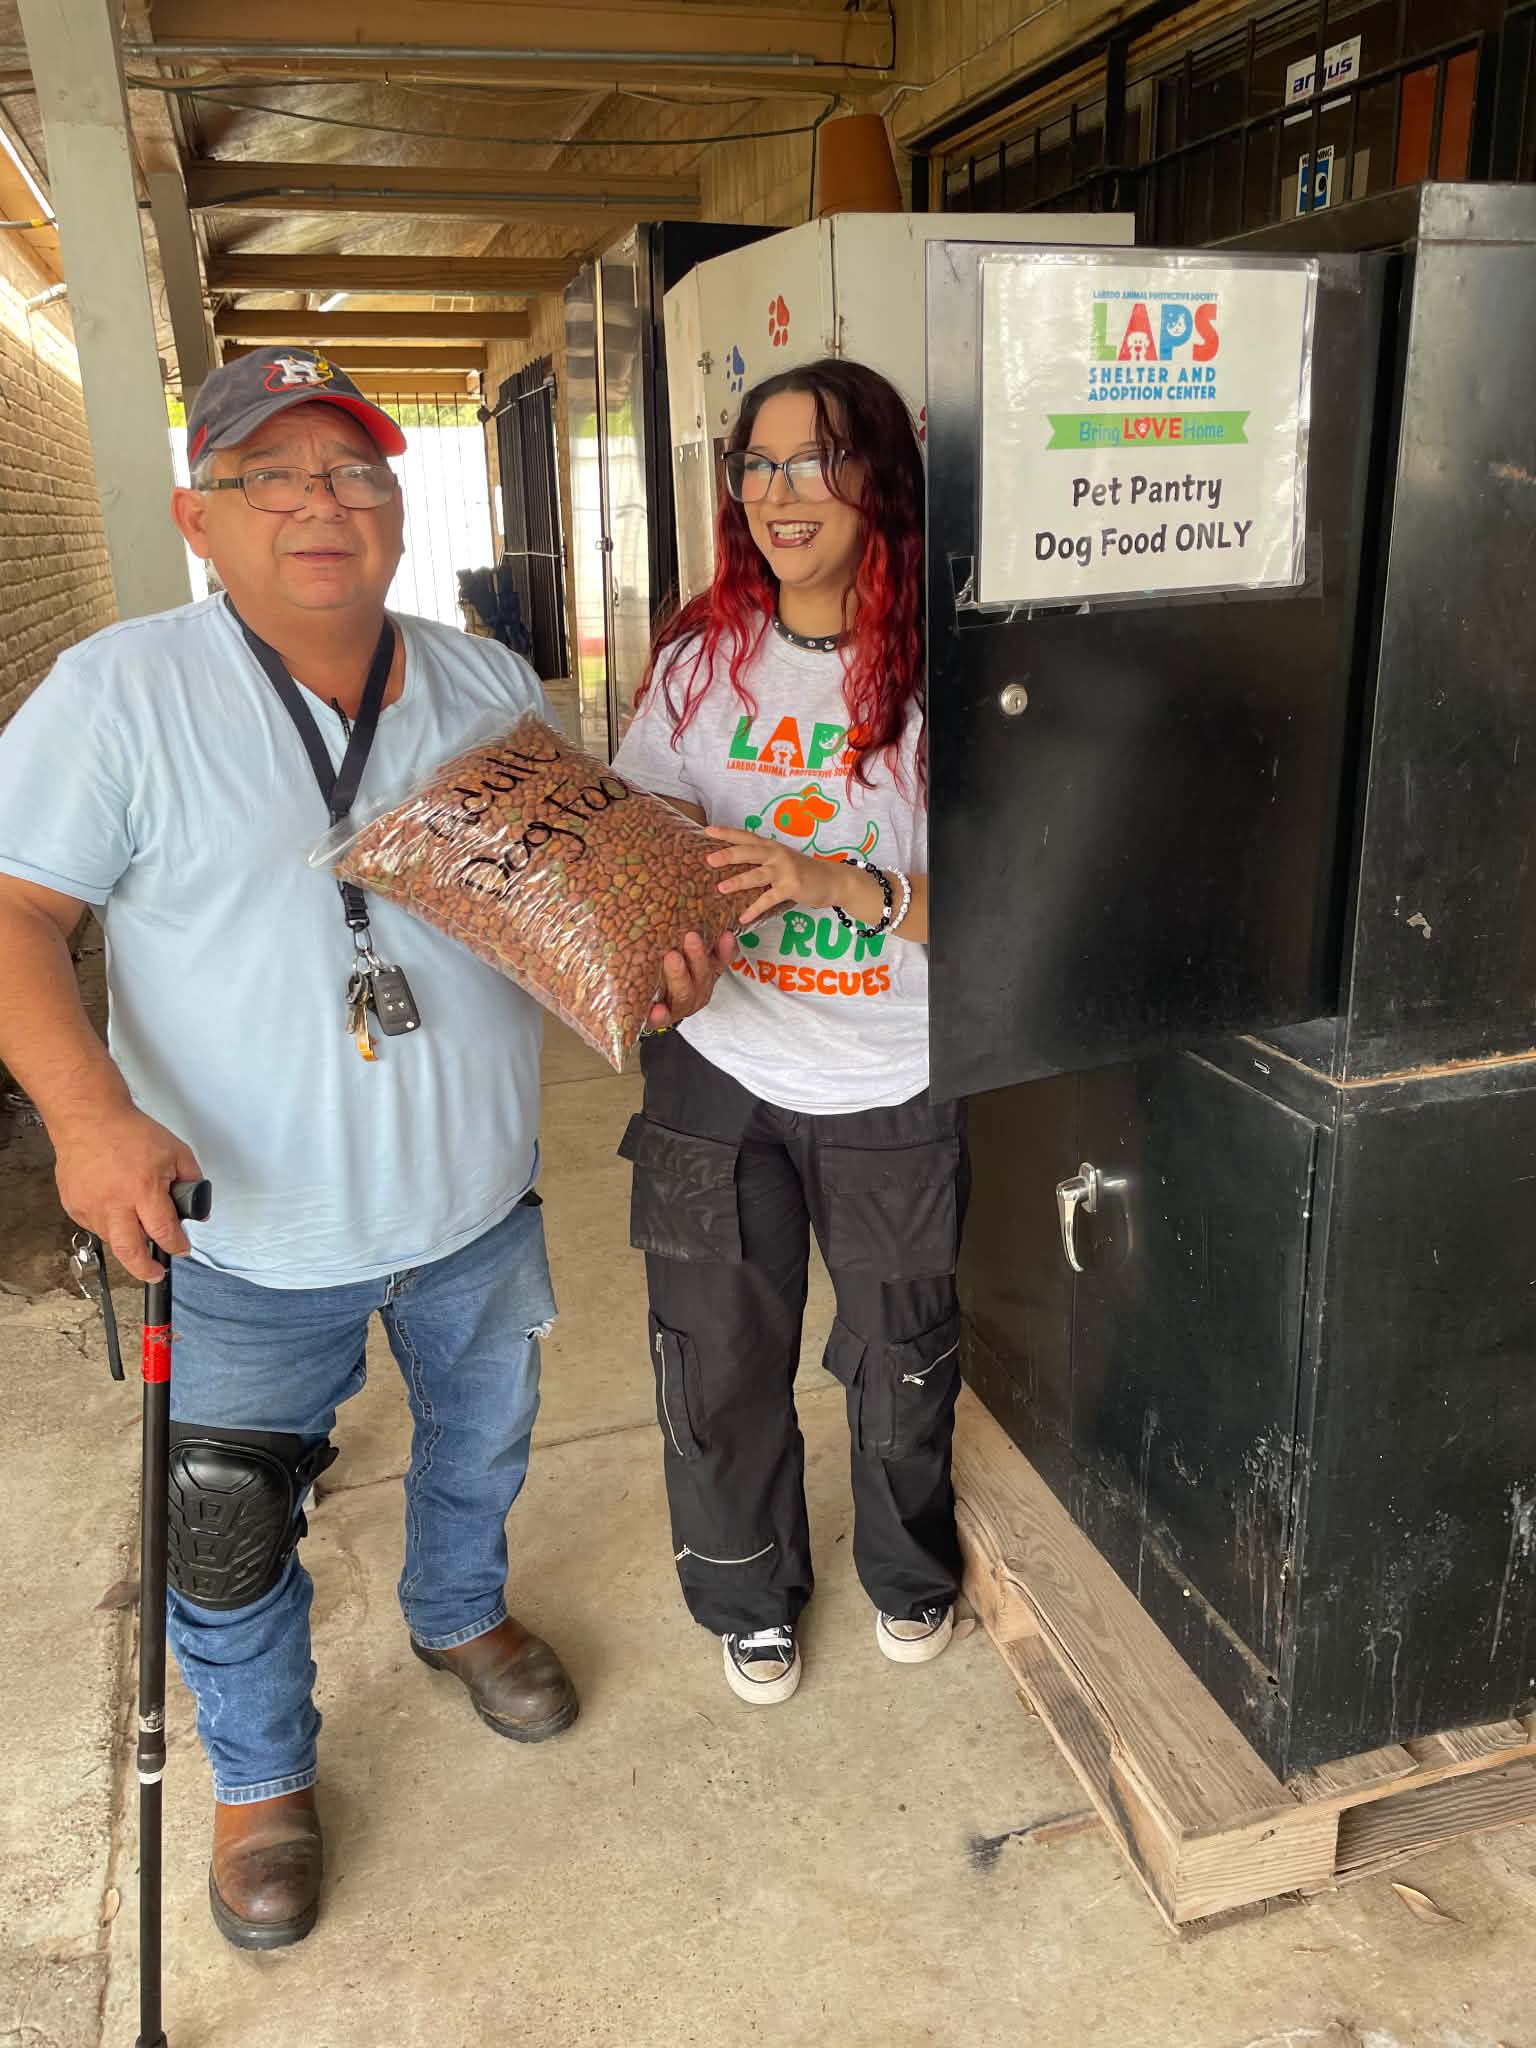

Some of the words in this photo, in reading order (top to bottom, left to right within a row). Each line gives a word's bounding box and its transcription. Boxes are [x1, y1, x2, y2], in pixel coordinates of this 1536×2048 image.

[1293, 57, 1353, 93] arus
[1090, 302, 1220, 362] LAPS
[1088, 367, 1169, 384] SHELTER
[1178, 367, 1216, 383] AND
[1088, 386, 1163, 401] ADOPTION
[1167, 385, 1216, 400] CENTER
[1079, 421, 1120, 447] Bring
[1184, 417, 1224, 438] Home
[1072, 477, 1122, 507] Pet
[1130, 474, 1222, 509] Pantry
[1035, 531, 1092, 567] Dog
[1101, 523, 1168, 556] Food
[1175, 520, 1253, 551] ONLY
[456, 821, 586, 900] Dog
[543, 776, 632, 821] Foo
[778, 911, 886, 962] RUN
[756, 960, 891, 996] RESCUES
